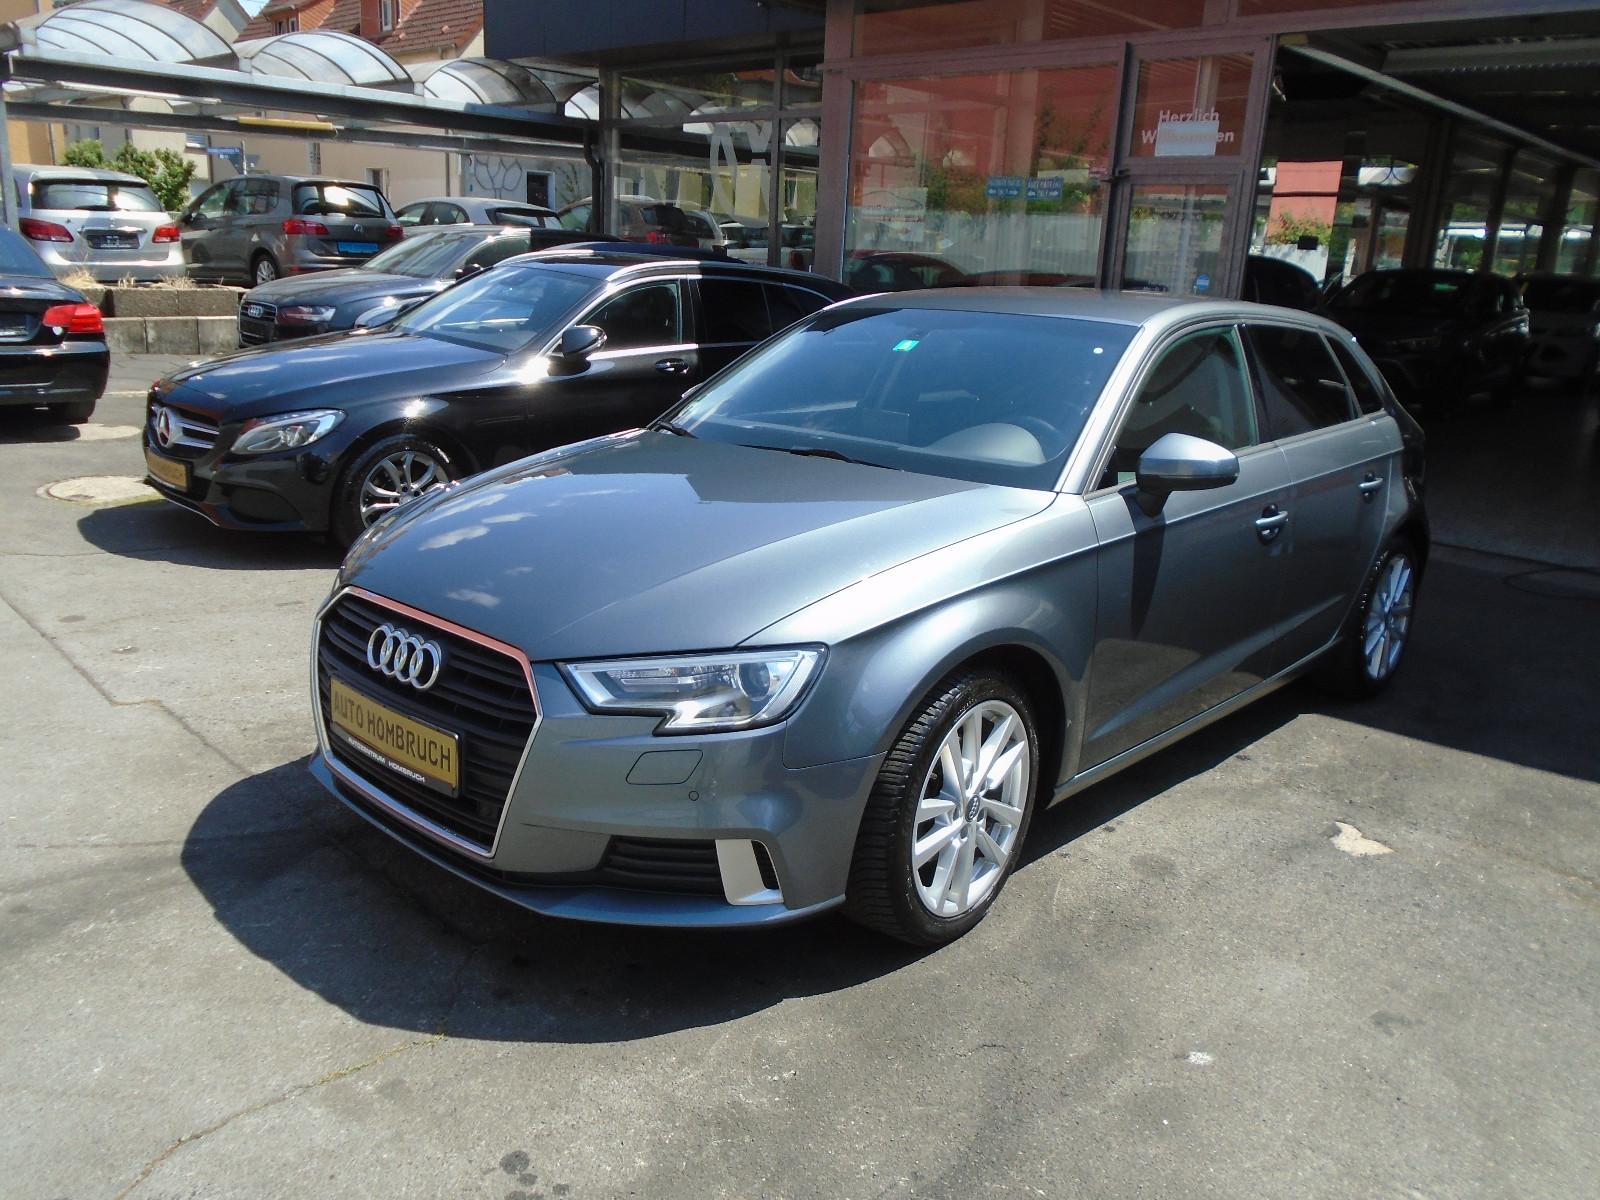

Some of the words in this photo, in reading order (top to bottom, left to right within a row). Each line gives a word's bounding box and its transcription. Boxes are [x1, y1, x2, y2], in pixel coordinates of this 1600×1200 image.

[1160, 107, 1219, 122] Herzlich
[334, 689, 364, 729] AUTO
[367, 710, 451, 773] HOMBRUCH
[388, 760, 426, 783] HOMBRUCH
